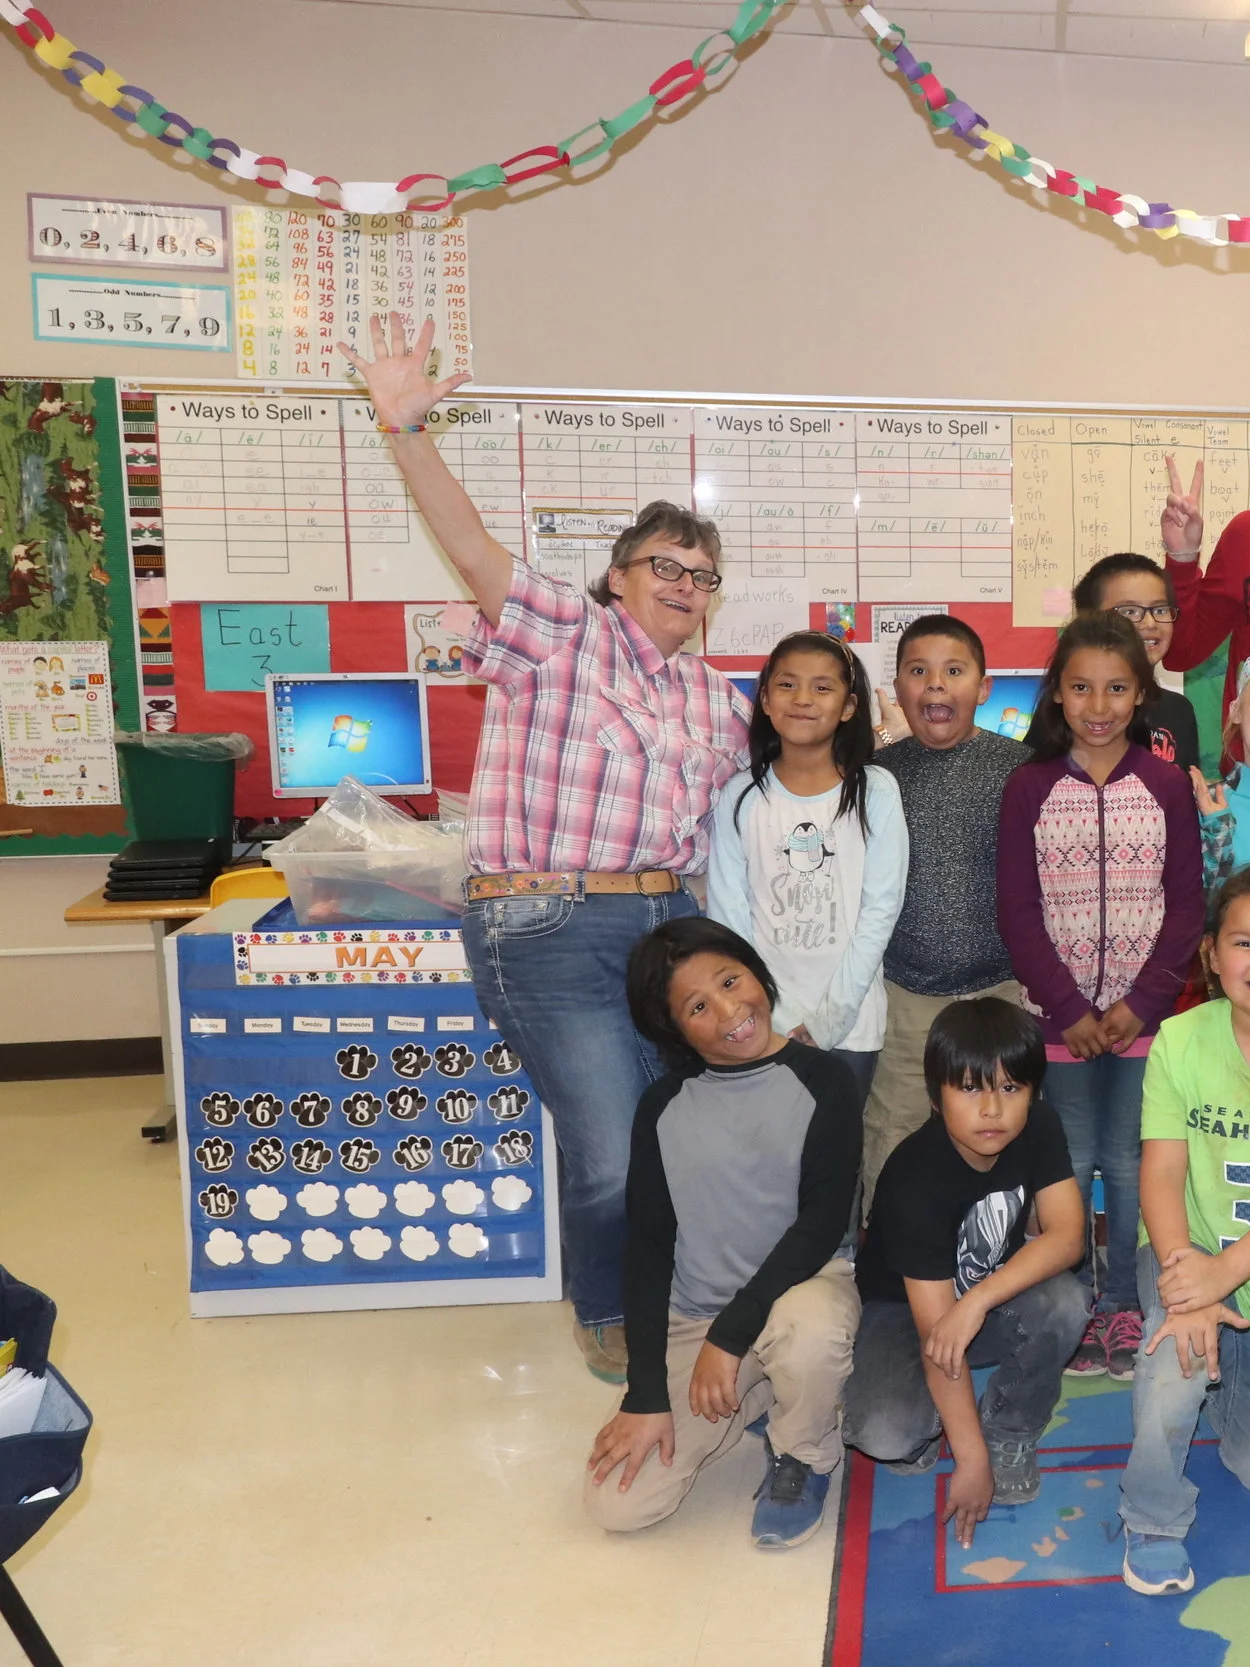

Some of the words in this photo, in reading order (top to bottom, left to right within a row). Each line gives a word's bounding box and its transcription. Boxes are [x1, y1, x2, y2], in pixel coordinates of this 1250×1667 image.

[288, 211, 307, 225] 120
[318, 214, 335, 228] 70
[370, 215, 387, 228] 60
[421, 216, 437, 228] 20
[288, 228, 309, 239] 108
[317, 231, 333, 243] 63
[195, 236, 216, 257] 8
[441, 235, 465, 247] 275
[293, 242, 307, 254] 96
[317, 246, 334, 258] 56
[370, 250, 386, 262] 48
[424, 251, 435, 262] 16
[443, 252, 466, 262] 250
[317, 261, 333, 276] 49
[443, 267, 465, 277] 225
[125, 290, 161, 298] Numbers
[199, 317, 220, 336] 9
[296, 362, 311, 374] 12
[322, 362, 329, 377] 7
[182, 401, 236, 422] Ways
[241, 403, 260, 420] to
[265, 404, 313, 424] Spell
[447, 408, 491, 426] Spell
[544, 410, 593, 429] Ways
[599, 413, 615, 426] to
[622, 412, 665, 430] Spell
[716, 415, 763, 434] Ways
[768, 418, 784, 432] to
[790, 417, 831, 436] Spell
[1133, 419, 1156, 429] Vowel
[1166, 421, 1203, 430] Consonant
[877, 418, 922, 437] Ways
[928, 420, 942, 434] to
[948, 420, 988, 438] Spell
[1017, 419, 1055, 436] Closed
[1076, 423, 1107, 438] Open
[1207, 425, 1229, 436] Vowel
[1134, 434, 1161, 444] Silent
[1208, 437, 1229, 445] Team
[217, 609, 302, 646] East
[251, 654, 274, 686] 3
[335, 945, 424, 969] MAY
[301, 1021, 323, 1029] Tuesday
[393, 1020, 418, 1028] Thursday
[446, 1020, 464, 1028] Friday
[349, 1053, 361, 1076] 1
[400, 1052, 416, 1074] 2
[447, 1051, 461, 1073] 3
[496, 1048, 512, 1071] 4
[214, 1099, 229, 1122] 5
[256, 1101, 271, 1123] 6
[303, 1101, 317, 1123] 7
[355, 1100, 370, 1123] 8
[397, 1094, 413, 1117] 9
[446, 1097, 469, 1121] 10
[498, 1093, 520, 1116] 11
[203, 1145, 229, 1170] 12
[253, 1144, 283, 1170] 13
[297, 1147, 322, 1171] 14
[347, 1146, 374, 1169] 15
[402, 1143, 428, 1169] 16
[449, 1142, 474, 1165] 17
[206, 1191, 230, 1216] 19
